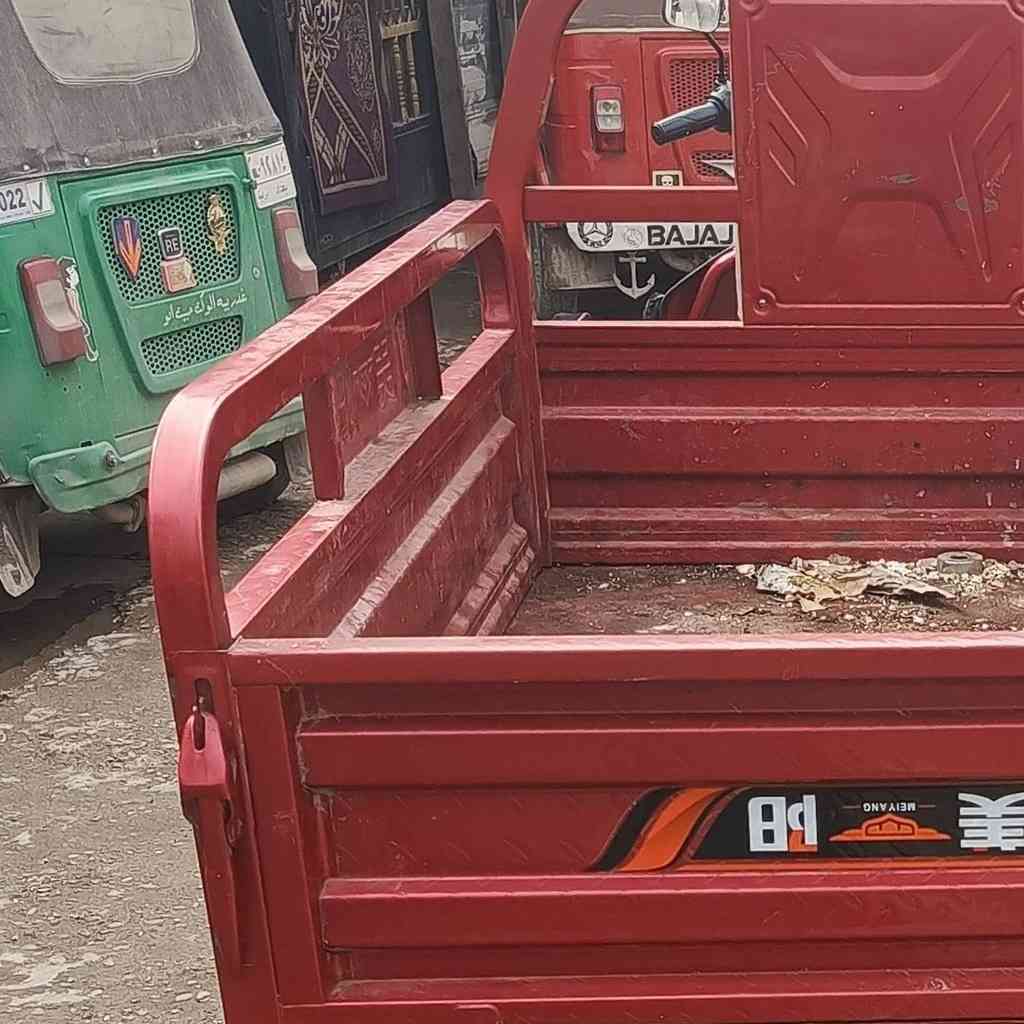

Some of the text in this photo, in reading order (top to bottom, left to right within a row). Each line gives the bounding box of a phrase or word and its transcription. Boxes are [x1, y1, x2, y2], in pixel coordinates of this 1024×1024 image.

[647, 224, 734, 246] BAJAJ
[862, 801, 918, 814] MEIYANG
[747, 793, 819, 853] 阳
